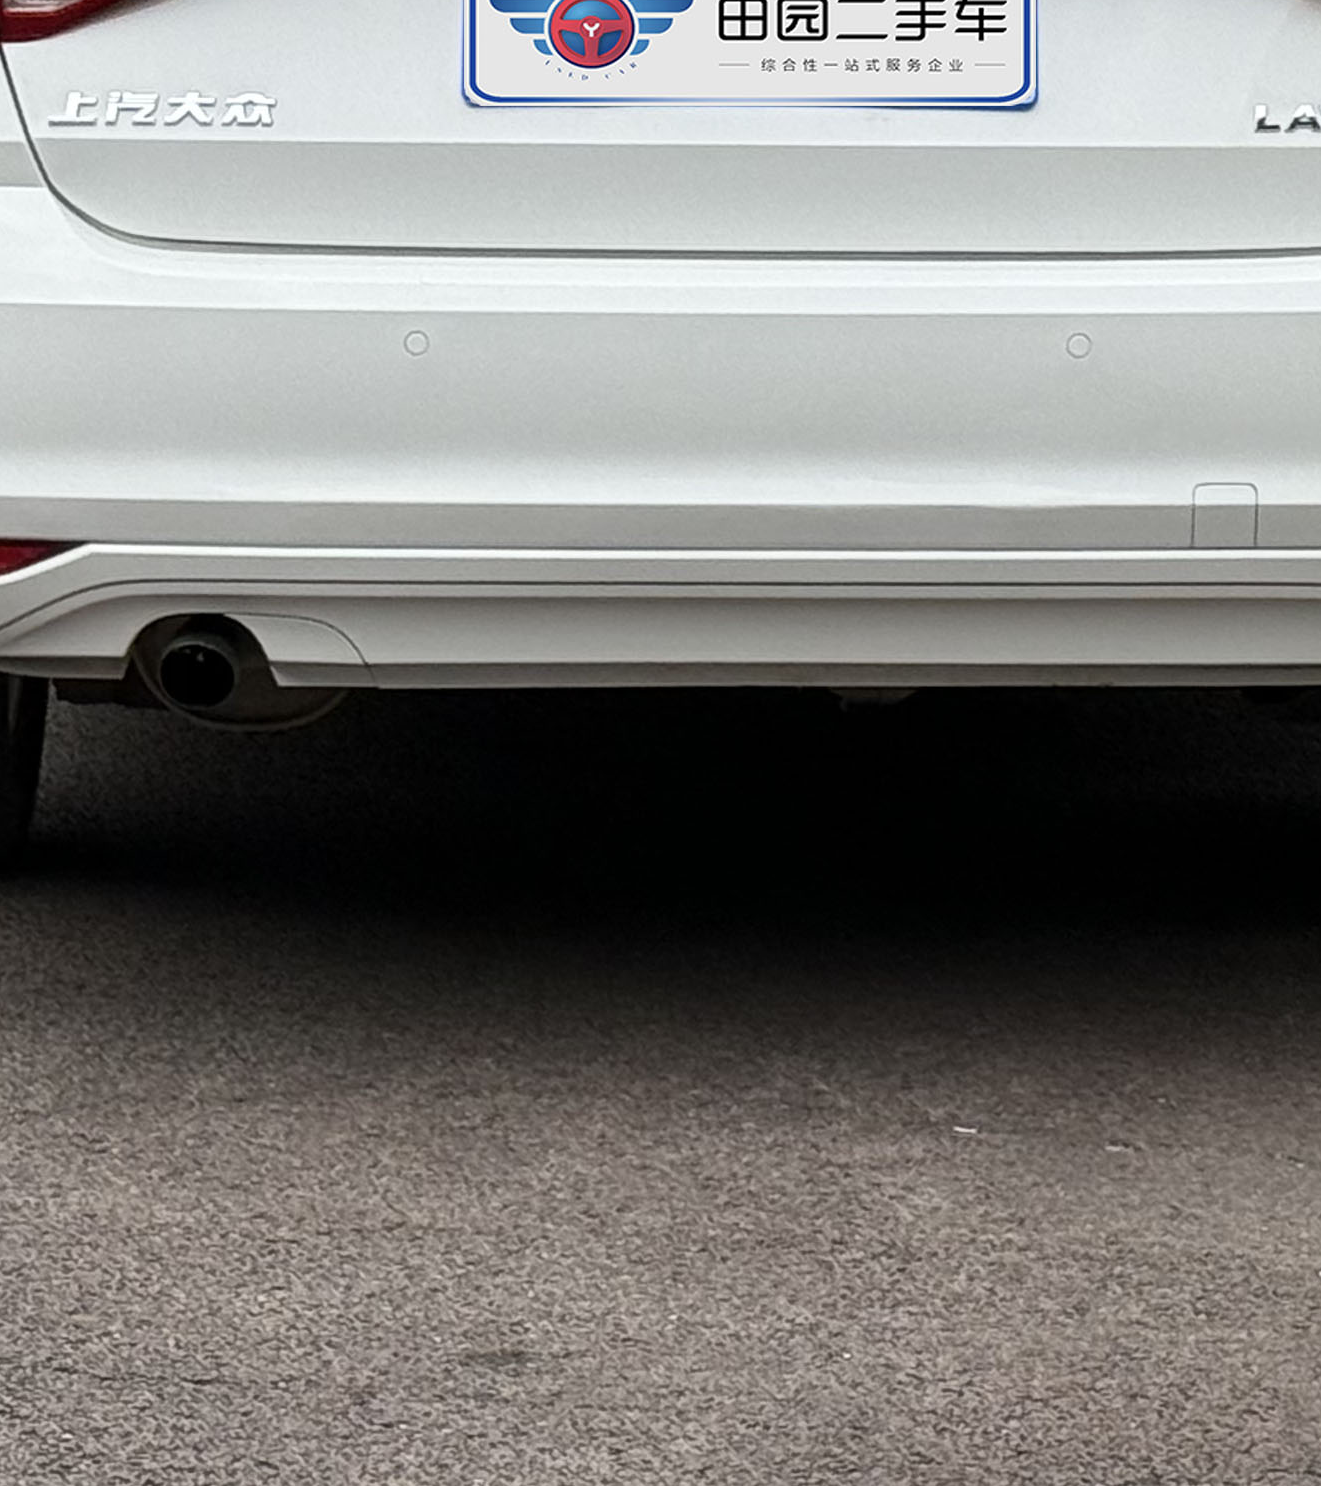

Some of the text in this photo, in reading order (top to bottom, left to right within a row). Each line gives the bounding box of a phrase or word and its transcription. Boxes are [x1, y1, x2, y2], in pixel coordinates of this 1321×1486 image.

[760, 57, 965, 73] 综合性一站式服务企业
[47, 90, 278, 127] 上汽大众
